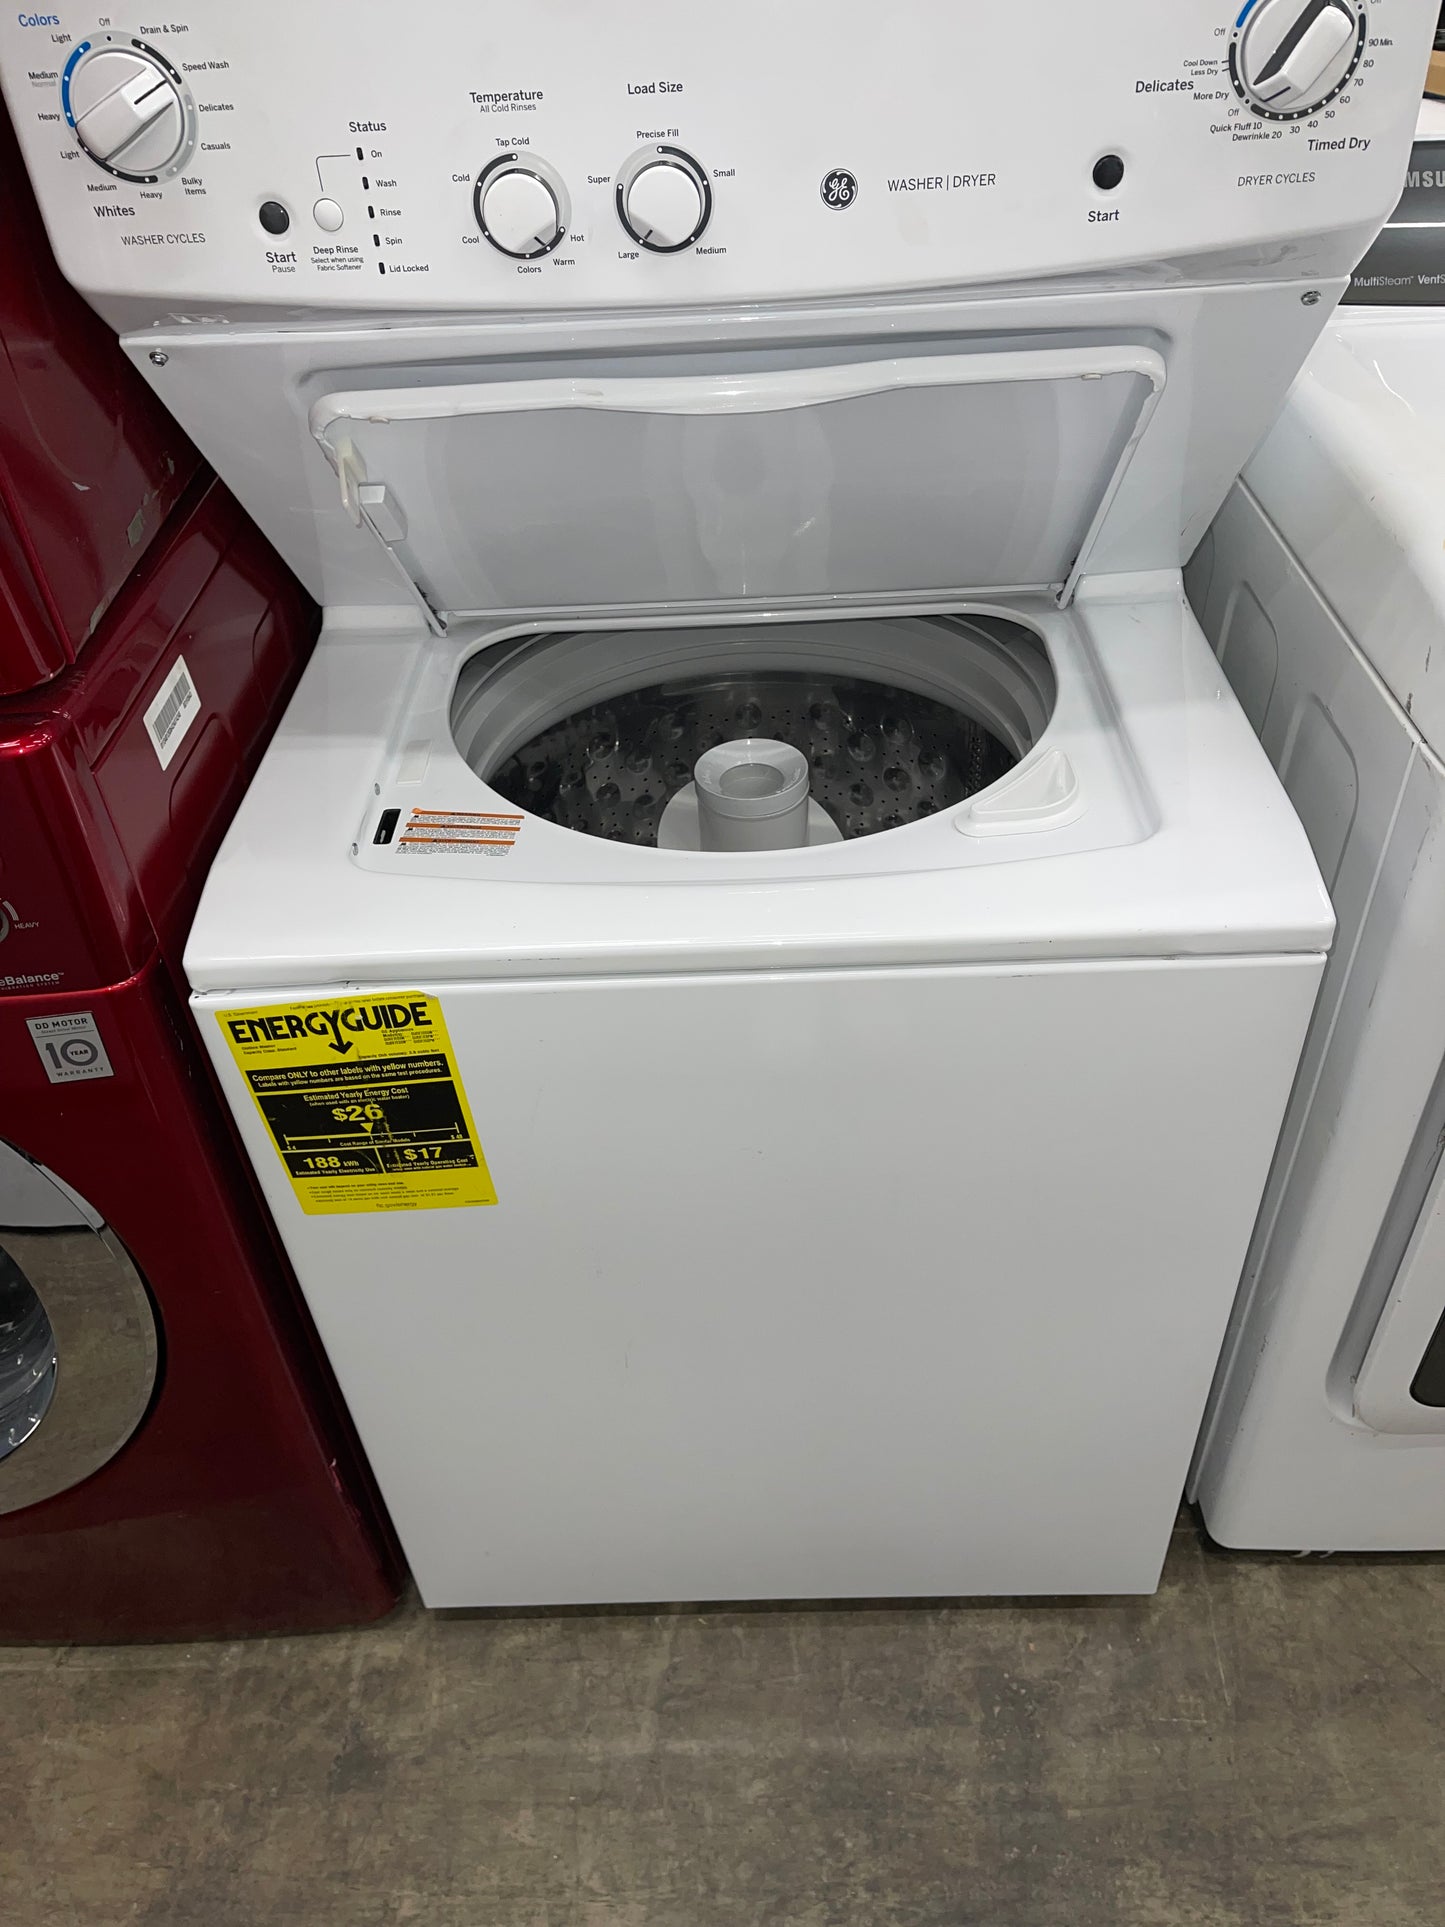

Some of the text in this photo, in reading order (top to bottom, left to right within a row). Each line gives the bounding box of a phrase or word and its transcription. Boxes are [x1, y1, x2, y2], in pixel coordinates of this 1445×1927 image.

[18, 13, 60, 27] Colors
[98, 17, 111, 26] Off
[140, 24, 189, 35] Drain & Spin
[1214, 28, 1226, 37] Off
[51, 34, 72, 43] Light
[1368, 38, 1379, 47] 90
[182, 61, 230, 72] Speed Wash
[1363, 60, 1374, 68] 80
[28, 71, 58, 80] Medium
[1207, 68, 1218, 76] Dry
[1135, 79, 1194, 94] Delicates
[1354, 78, 1364, 87] 70
[627, 81, 683, 95] Load Size
[469, 89, 544, 104] Temperature
[1193, 91, 1229, 100] More Dry
[198, 103, 234, 112] Delicates
[480, 103, 537, 113] All Cold Rinses
[38, 112, 60, 122] Heavy
[1227, 108, 1240, 117] Off
[1324, 110, 1335, 118] 50
[349, 121, 387, 132] Status
[1210, 124, 1232, 134] Quick
[1234, 122, 1252, 131] Fluff
[1307, 120, 1318, 128] 40
[636, 128, 679, 139] Precise Fill
[1289, 126, 1300, 134] 30
[1232, 131, 1282, 141] Dewrinkle 20
[200, 142, 231, 151] Casuals
[496, 137, 530, 148] Tap Cold
[1308, 137, 1371, 151] Timed Dry
[60, 150, 80, 159] Light
[371, 150, 382, 158] On
[452, 174, 470, 182] Cold
[713, 169, 736, 178] Small
[181, 177, 203, 186] Bulky
[376, 179, 397, 187] Wash
[587, 175, 611, 185] Super
[887, 173, 996, 192] WASHER DRYER
[1237, 172, 1315, 187] DRYER CYCLES
[87, 183, 117, 192] Medium
[184, 187, 207, 196] Items
[140, 191, 163, 200] Heavy
[94, 206, 135, 217] Whites
[380, 208, 401, 216] Rinse
[1088, 208, 1120, 223] Start
[121, 233, 206, 246] WASHER CYCLES
[385, 237, 403, 245] Spin
[462, 236, 480, 244] Cool
[570, 234, 584, 242] Hot
[313, 245, 358, 255] Deep Rinse
[696, 246, 727, 255] Medium
[266, 251, 297, 263] Start
[618, 251, 640, 260] Large
[553, 258, 575, 266] Warm
[272, 265, 296, 273] Pause
[389, 264, 429, 273] Lid Locked
[517, 266, 542, 274] Colors
[14, 921, 40, 930] HEAVY
[35, 1022, 49, 1030] DD
[52, 1017, 88, 1028] MOTOR
[227, 1002, 432, 1043] ENERGYGUIDE
[46, 1039, 98, 1069] 10
[56, 1067, 104, 1077] WARRANTY
[251, 1073, 286, 1082] Compare
[381, 1062, 407, 1071] yellow
[407, 1059, 443, 1068] numbers.
[303, 1093, 340, 1101] Estimated
[339, 1091, 364, 1099] Yearly
[363, 1088, 390, 1097] Energy
[330, 1103, 384, 1122] $26
[402, 1146, 444, 1160] $17
[302, 1155, 341, 1169] 188
